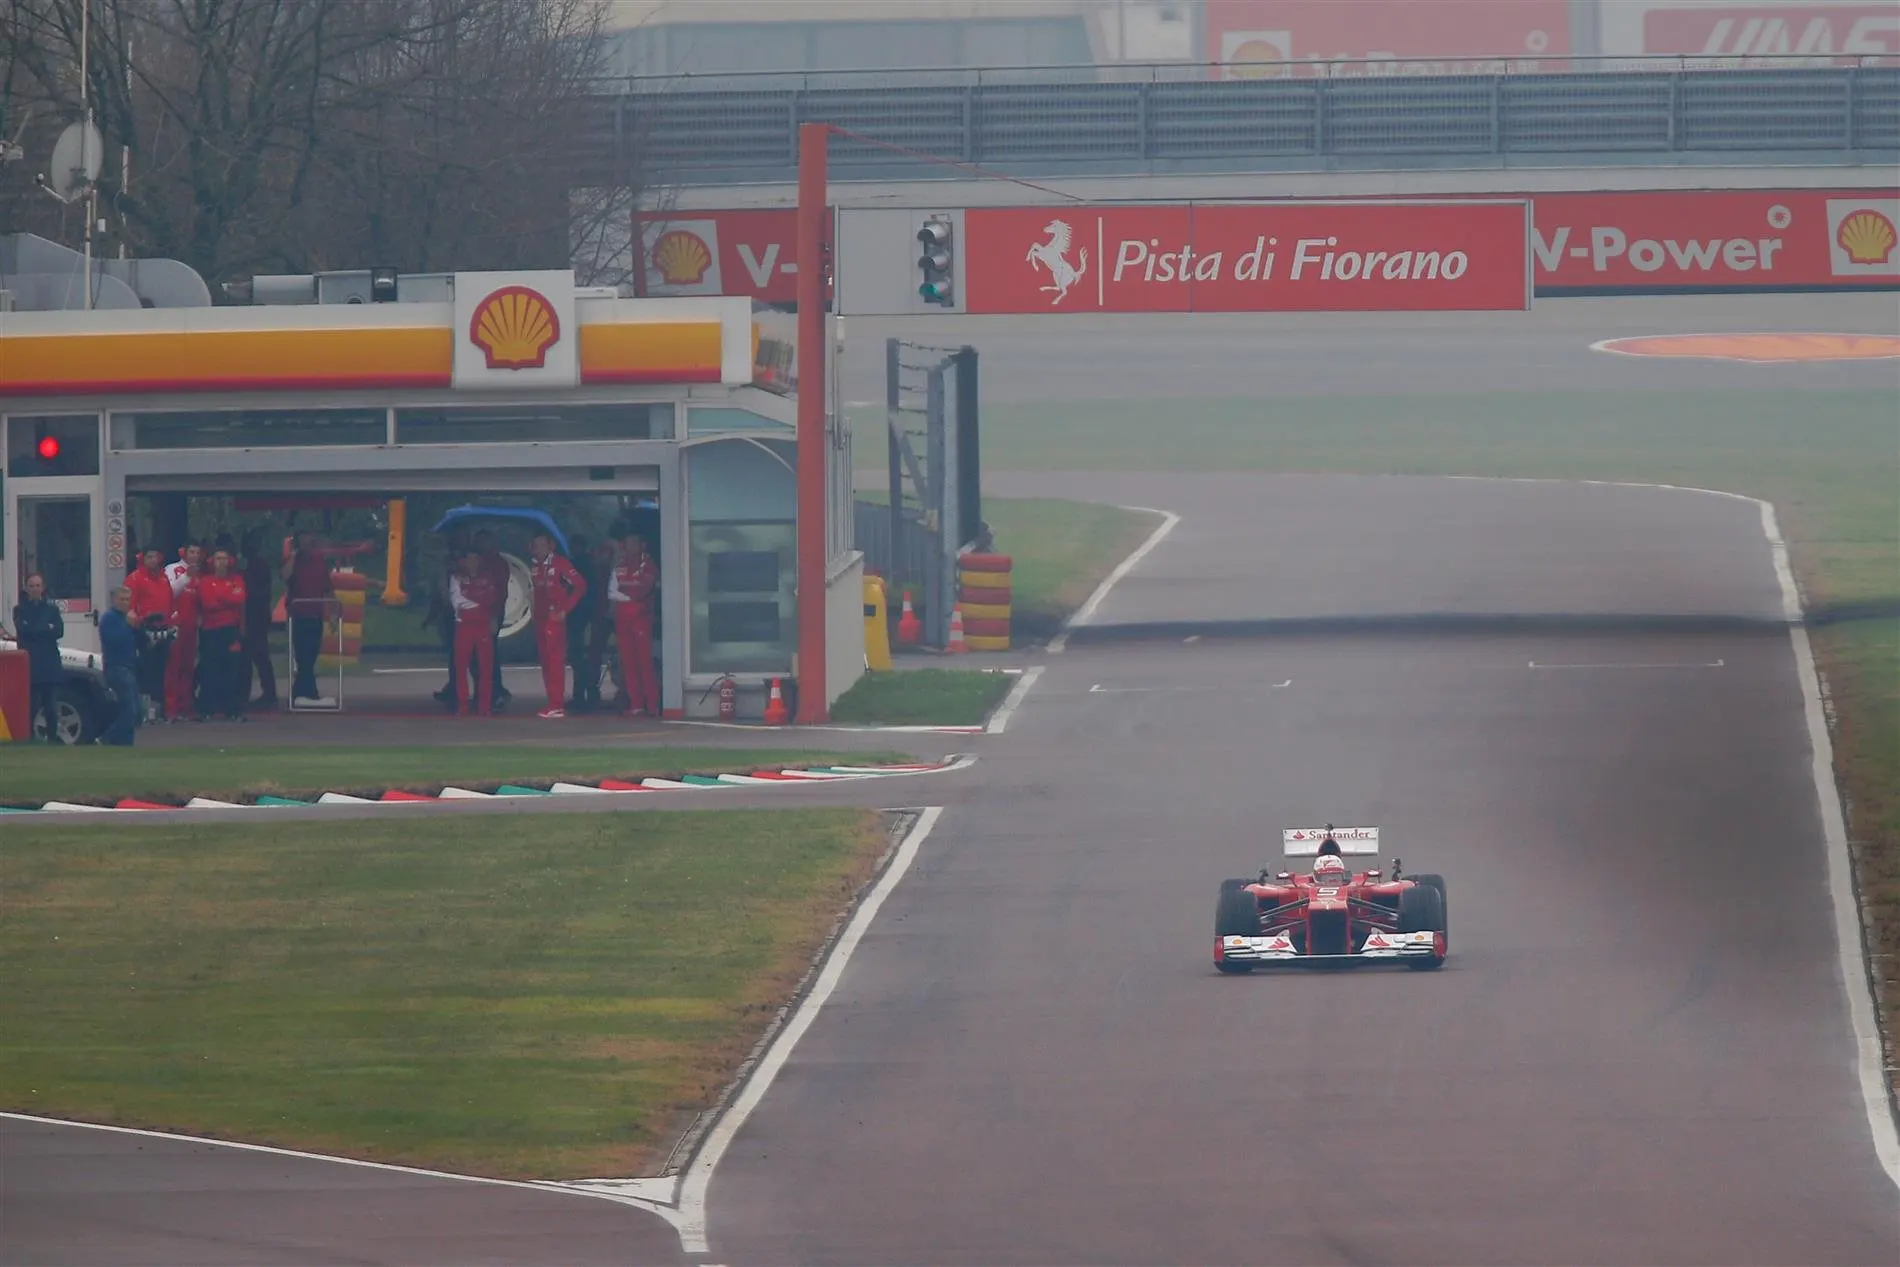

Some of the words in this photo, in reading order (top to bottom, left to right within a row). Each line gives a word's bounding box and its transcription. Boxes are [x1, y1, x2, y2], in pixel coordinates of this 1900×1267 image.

[1113, 238, 1223, 282] Pista
[1233, 235, 1278, 281] di
[1290, 236, 1468, 281] Fiorano
[1533, 226, 1783, 272] V-Power
[1308, 829, 1370, 840] Santander
